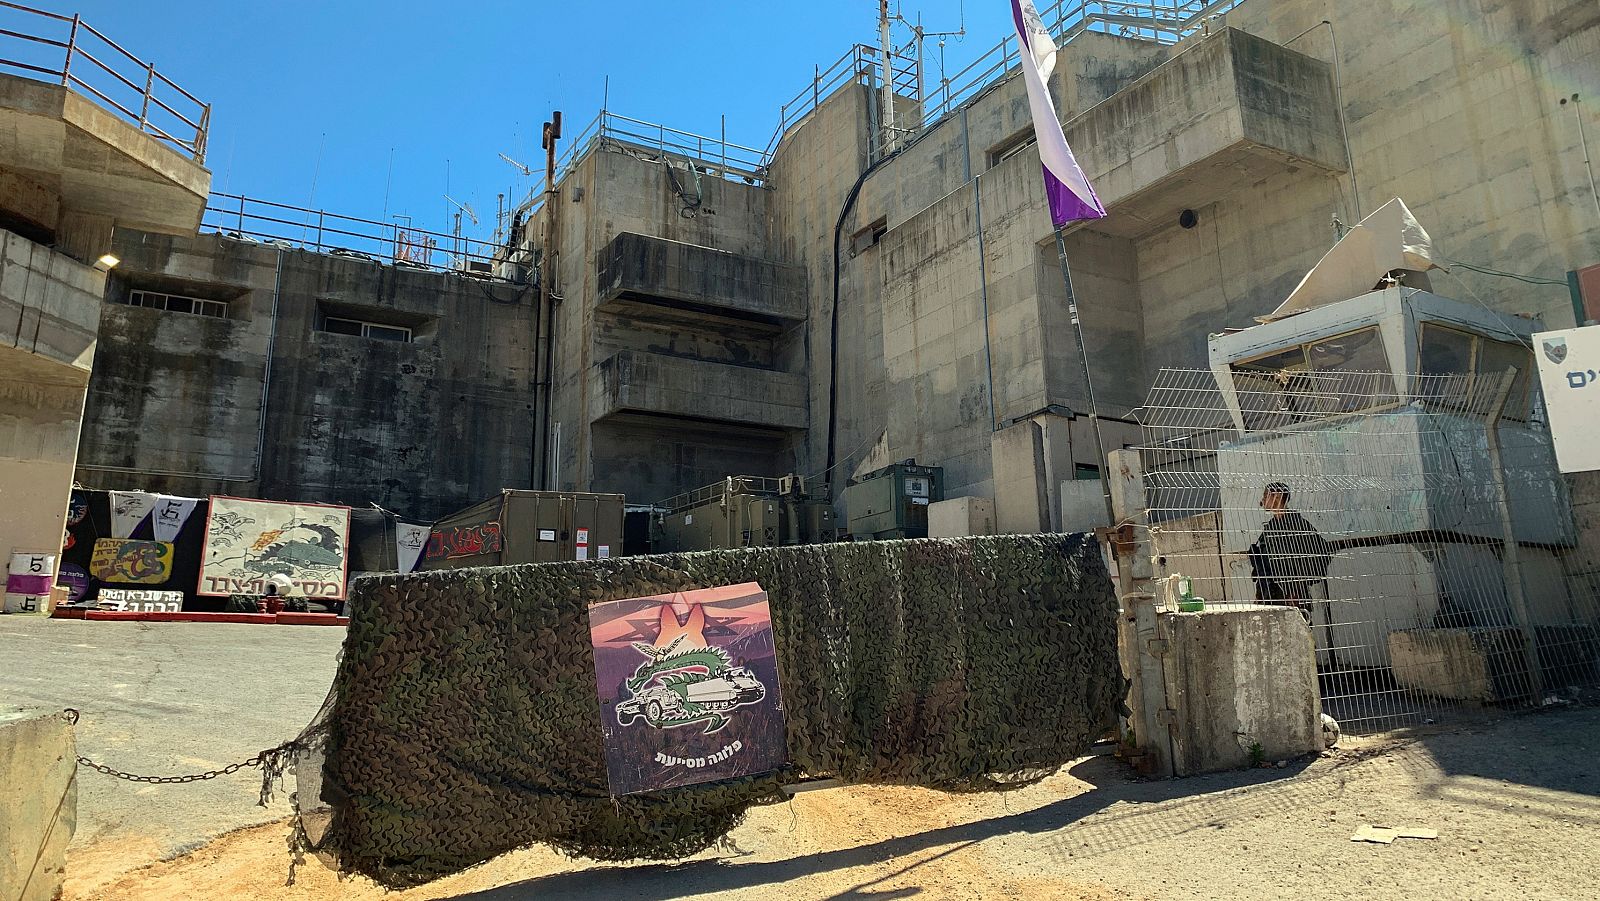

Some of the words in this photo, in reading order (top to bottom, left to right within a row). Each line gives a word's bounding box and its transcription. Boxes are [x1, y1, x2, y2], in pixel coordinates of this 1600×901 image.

[1566, 370, 1600, 388] ים
[654, 751, 706, 769] מסייעת
[708, 740, 743, 765] פלוגה
